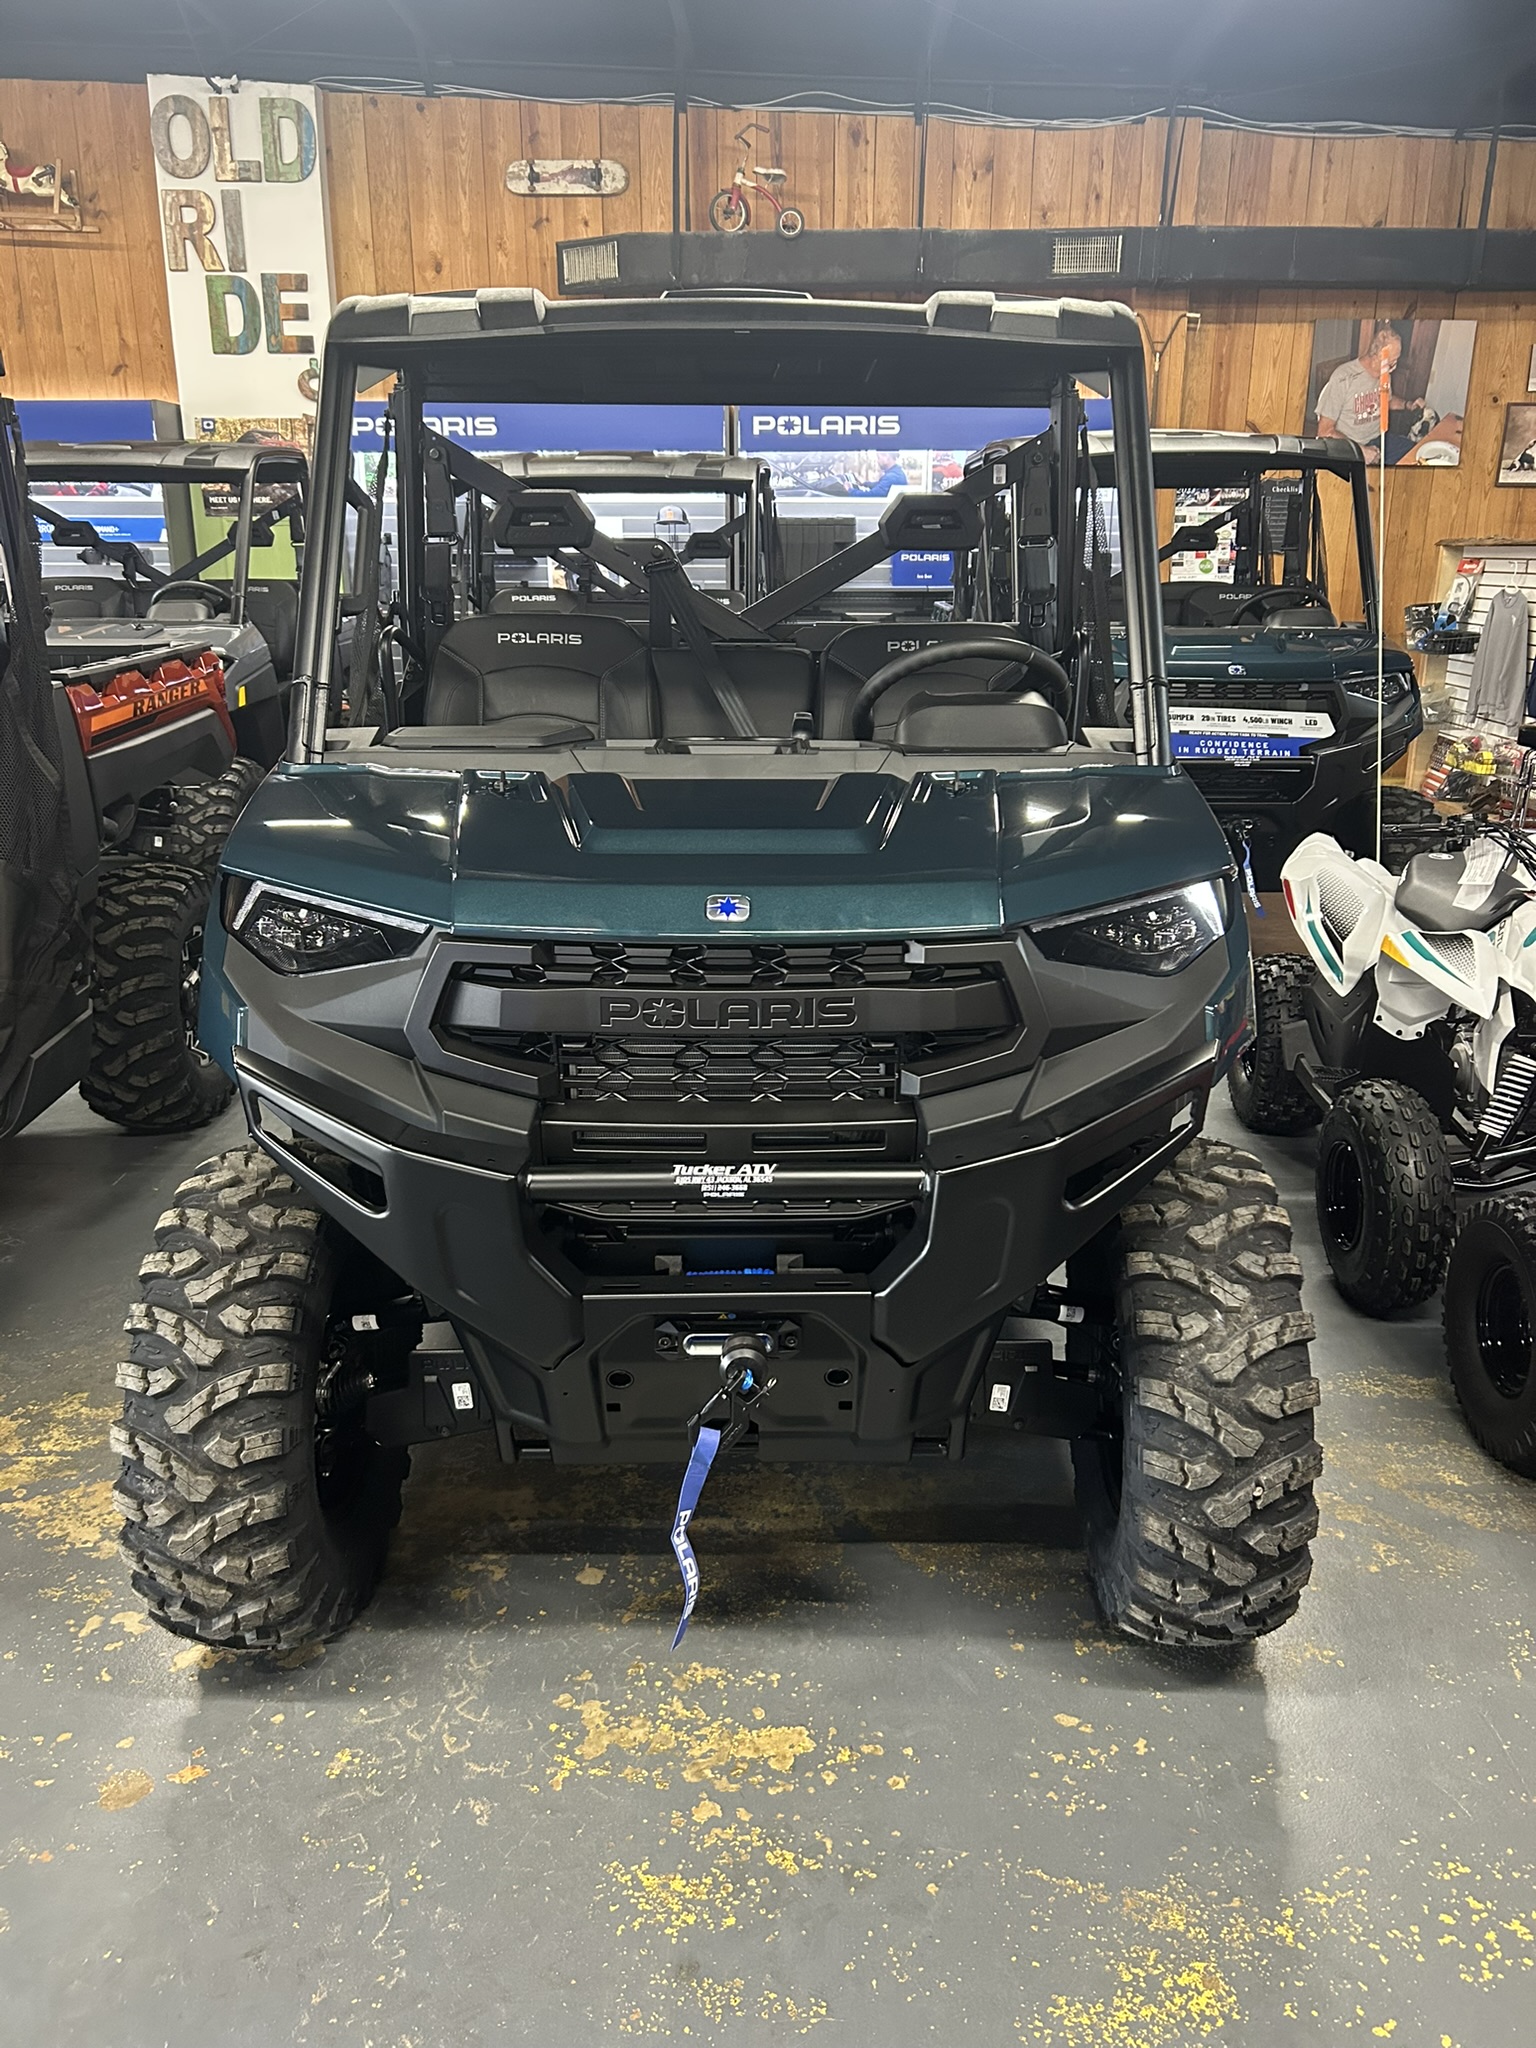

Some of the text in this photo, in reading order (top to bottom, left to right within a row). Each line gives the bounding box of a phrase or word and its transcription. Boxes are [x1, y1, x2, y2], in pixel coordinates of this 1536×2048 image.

[151, 94, 317, 183] OLD
[351, 416, 499, 437] POARIS
[752, 415, 901, 436] POLARIS
[1271, 486, 1300, 494] Checklis
[209, 496, 227, 504] MEET
[901, 553, 950, 562] POLARIS
[54, 584, 94, 592] POLARIS
[511, 594, 557, 602] POLARIS
[497, 632, 583, 645] POLARIS
[133, 680, 201, 718] RANGER
[1216, 715, 1237, 723] TIRES
[1270, 717, 1293, 725] WINCH
[1199, 739, 1269, 749] CONFIDENCE
[1195, 747, 1238, 755] RUGGED
[1243, 748, 1291, 757] TERRAIN
[1244, 867, 1262, 909] POLARIS
[600, 996, 858, 1029] POLARIS
[671, 1163, 778, 1176] Tucker ATV
